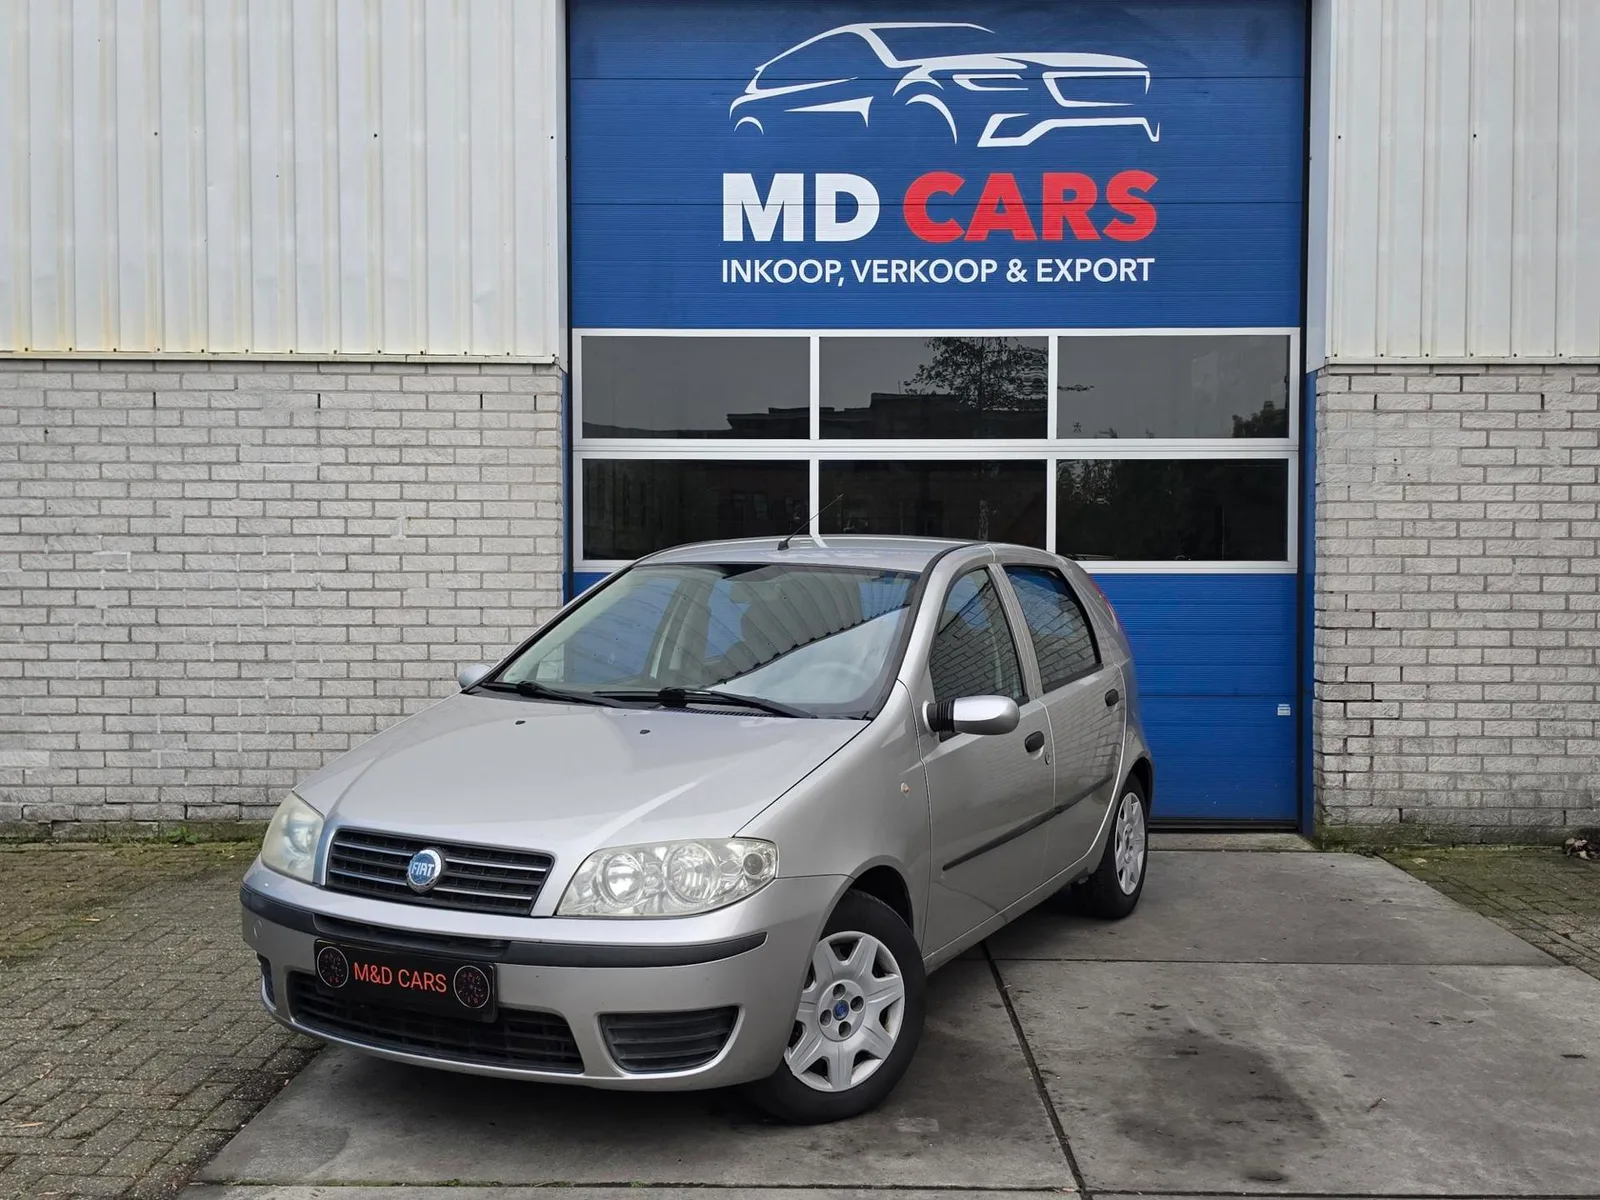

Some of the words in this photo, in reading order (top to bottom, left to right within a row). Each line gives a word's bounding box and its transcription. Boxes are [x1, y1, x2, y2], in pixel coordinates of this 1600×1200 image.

[723, 172, 880, 242] MD
[903, 169, 1159, 243] CARS
[722, 259, 844, 287] INKOOP,
[851, 259, 998, 283] VERKOOP
[1006, 259, 1028, 283] &
[1036, 257, 1155, 283] EXPORT
[411, 861, 435, 877] FIAT
[353, 962, 393, 985] M&D
[398, 968, 447, 993] CARS
